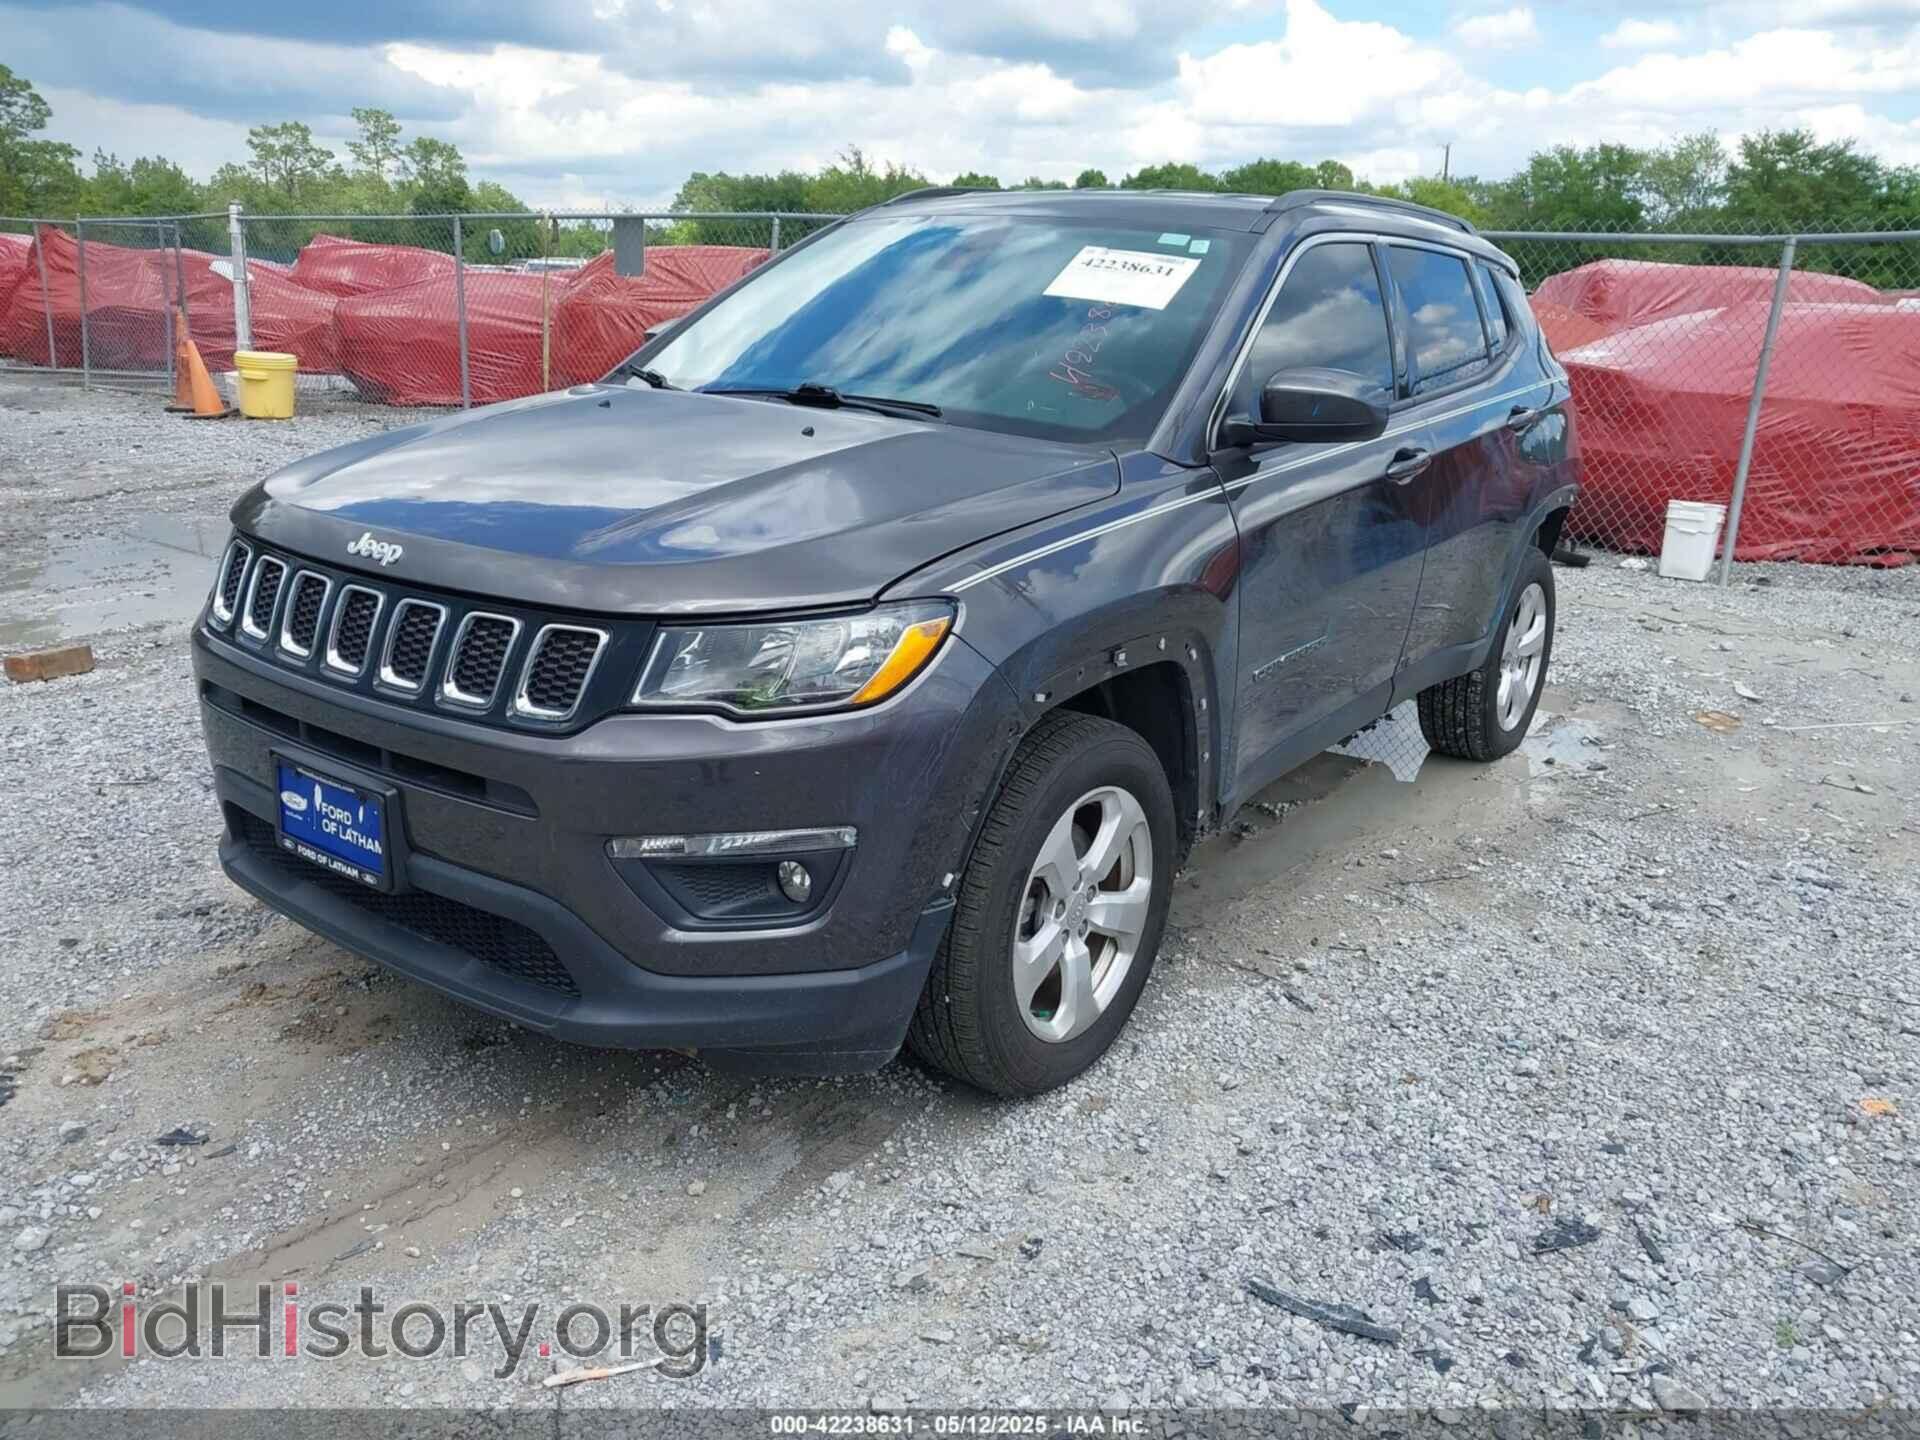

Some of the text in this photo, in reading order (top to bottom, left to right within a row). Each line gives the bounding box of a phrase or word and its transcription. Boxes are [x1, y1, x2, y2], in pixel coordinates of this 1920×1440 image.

[1081, 258, 1174, 276] 42238631
[347, 532, 403, 566] Jeep
[320, 802, 352, 825] FORD
[321, 819, 338, 835] OF
[297, 844, 317, 860] FORD
[317, 853, 328, 864] OF
[328, 858, 359, 879] LATHAM
